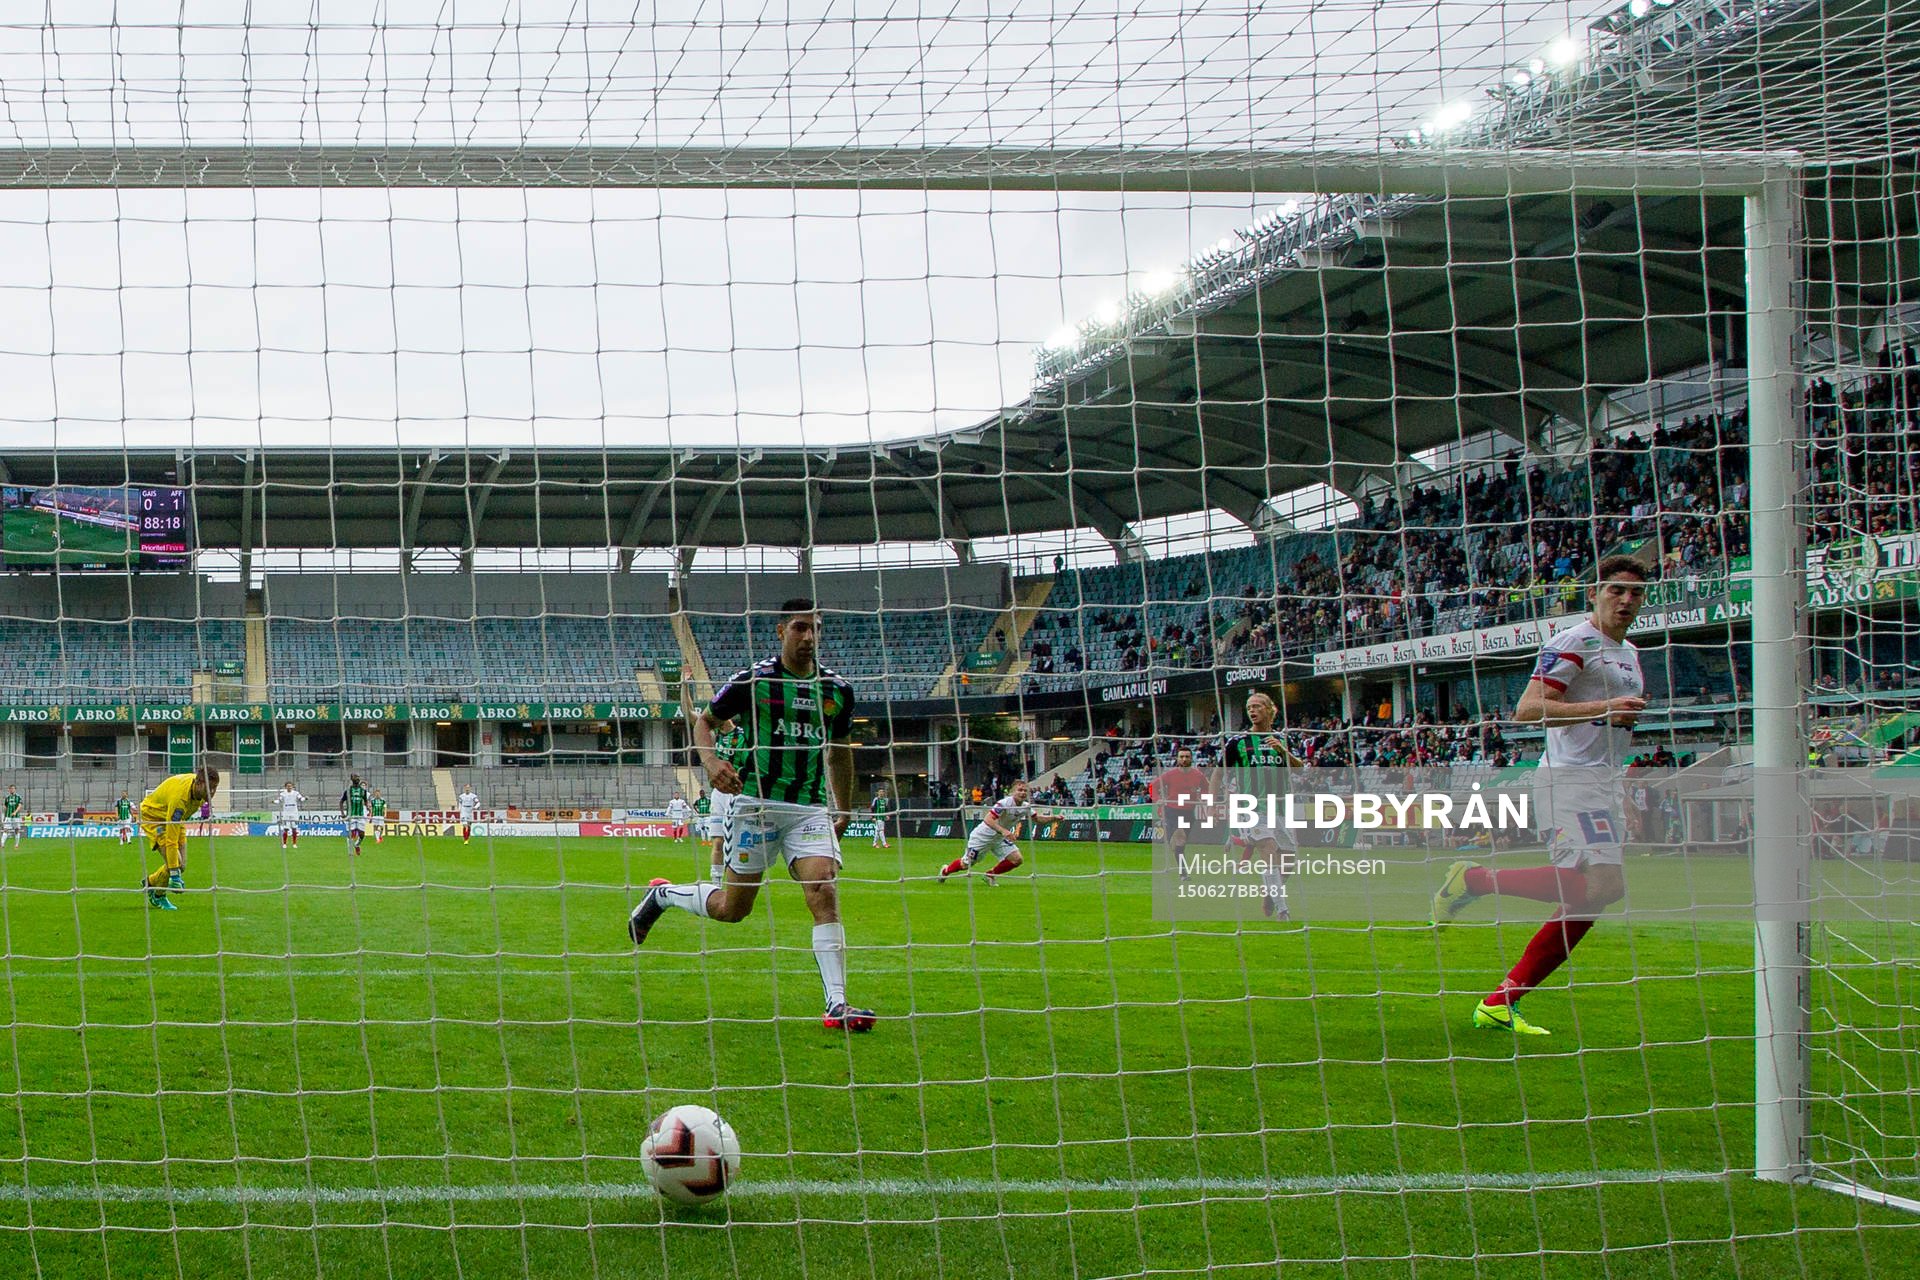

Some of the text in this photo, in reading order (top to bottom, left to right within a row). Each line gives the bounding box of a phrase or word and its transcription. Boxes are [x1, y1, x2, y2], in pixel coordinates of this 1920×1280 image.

[144, 498, 152, 510] 0
[173, 498, 179, 510] 1
[144, 517, 180, 529] 88:18
[1394, 649, 1417, 661] RASTA
[1422, 645, 1446, 658] RASTA
[1482, 637, 1509, 650] RASTA
[1515, 632, 1544, 646] RASTA
[1102, 684, 1131, 701] GAMLA
[773, 718, 826, 740] ÅBRO
[627, 809, 666, 818] Västkus
[602, 824, 667, 837] Scandic
